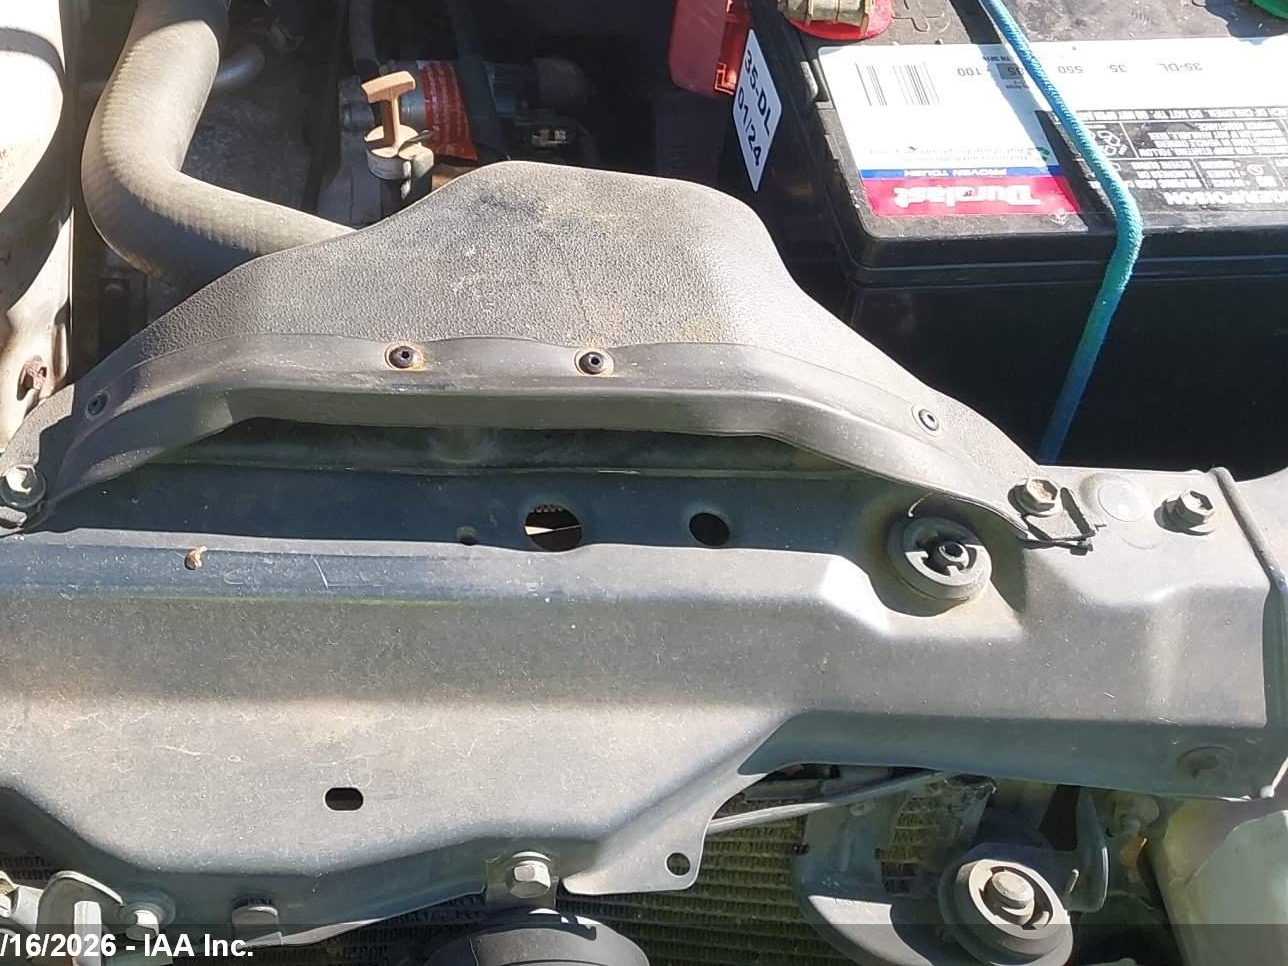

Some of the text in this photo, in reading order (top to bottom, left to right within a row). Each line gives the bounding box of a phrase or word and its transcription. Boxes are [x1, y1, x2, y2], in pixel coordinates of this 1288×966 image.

[957, 67, 982, 77] 100
[1058, 65, 1084, 74] 550
[1109, 64, 1127, 73] 35
[1158, 62, 1203, 73] 35-DL
[742, 47, 773, 133] 35-DL
[736, 87, 764, 168] 01/24
[903, 168, 1008, 177] PROVEN TOUGH
[893, 184, 1043, 209] Duralast
